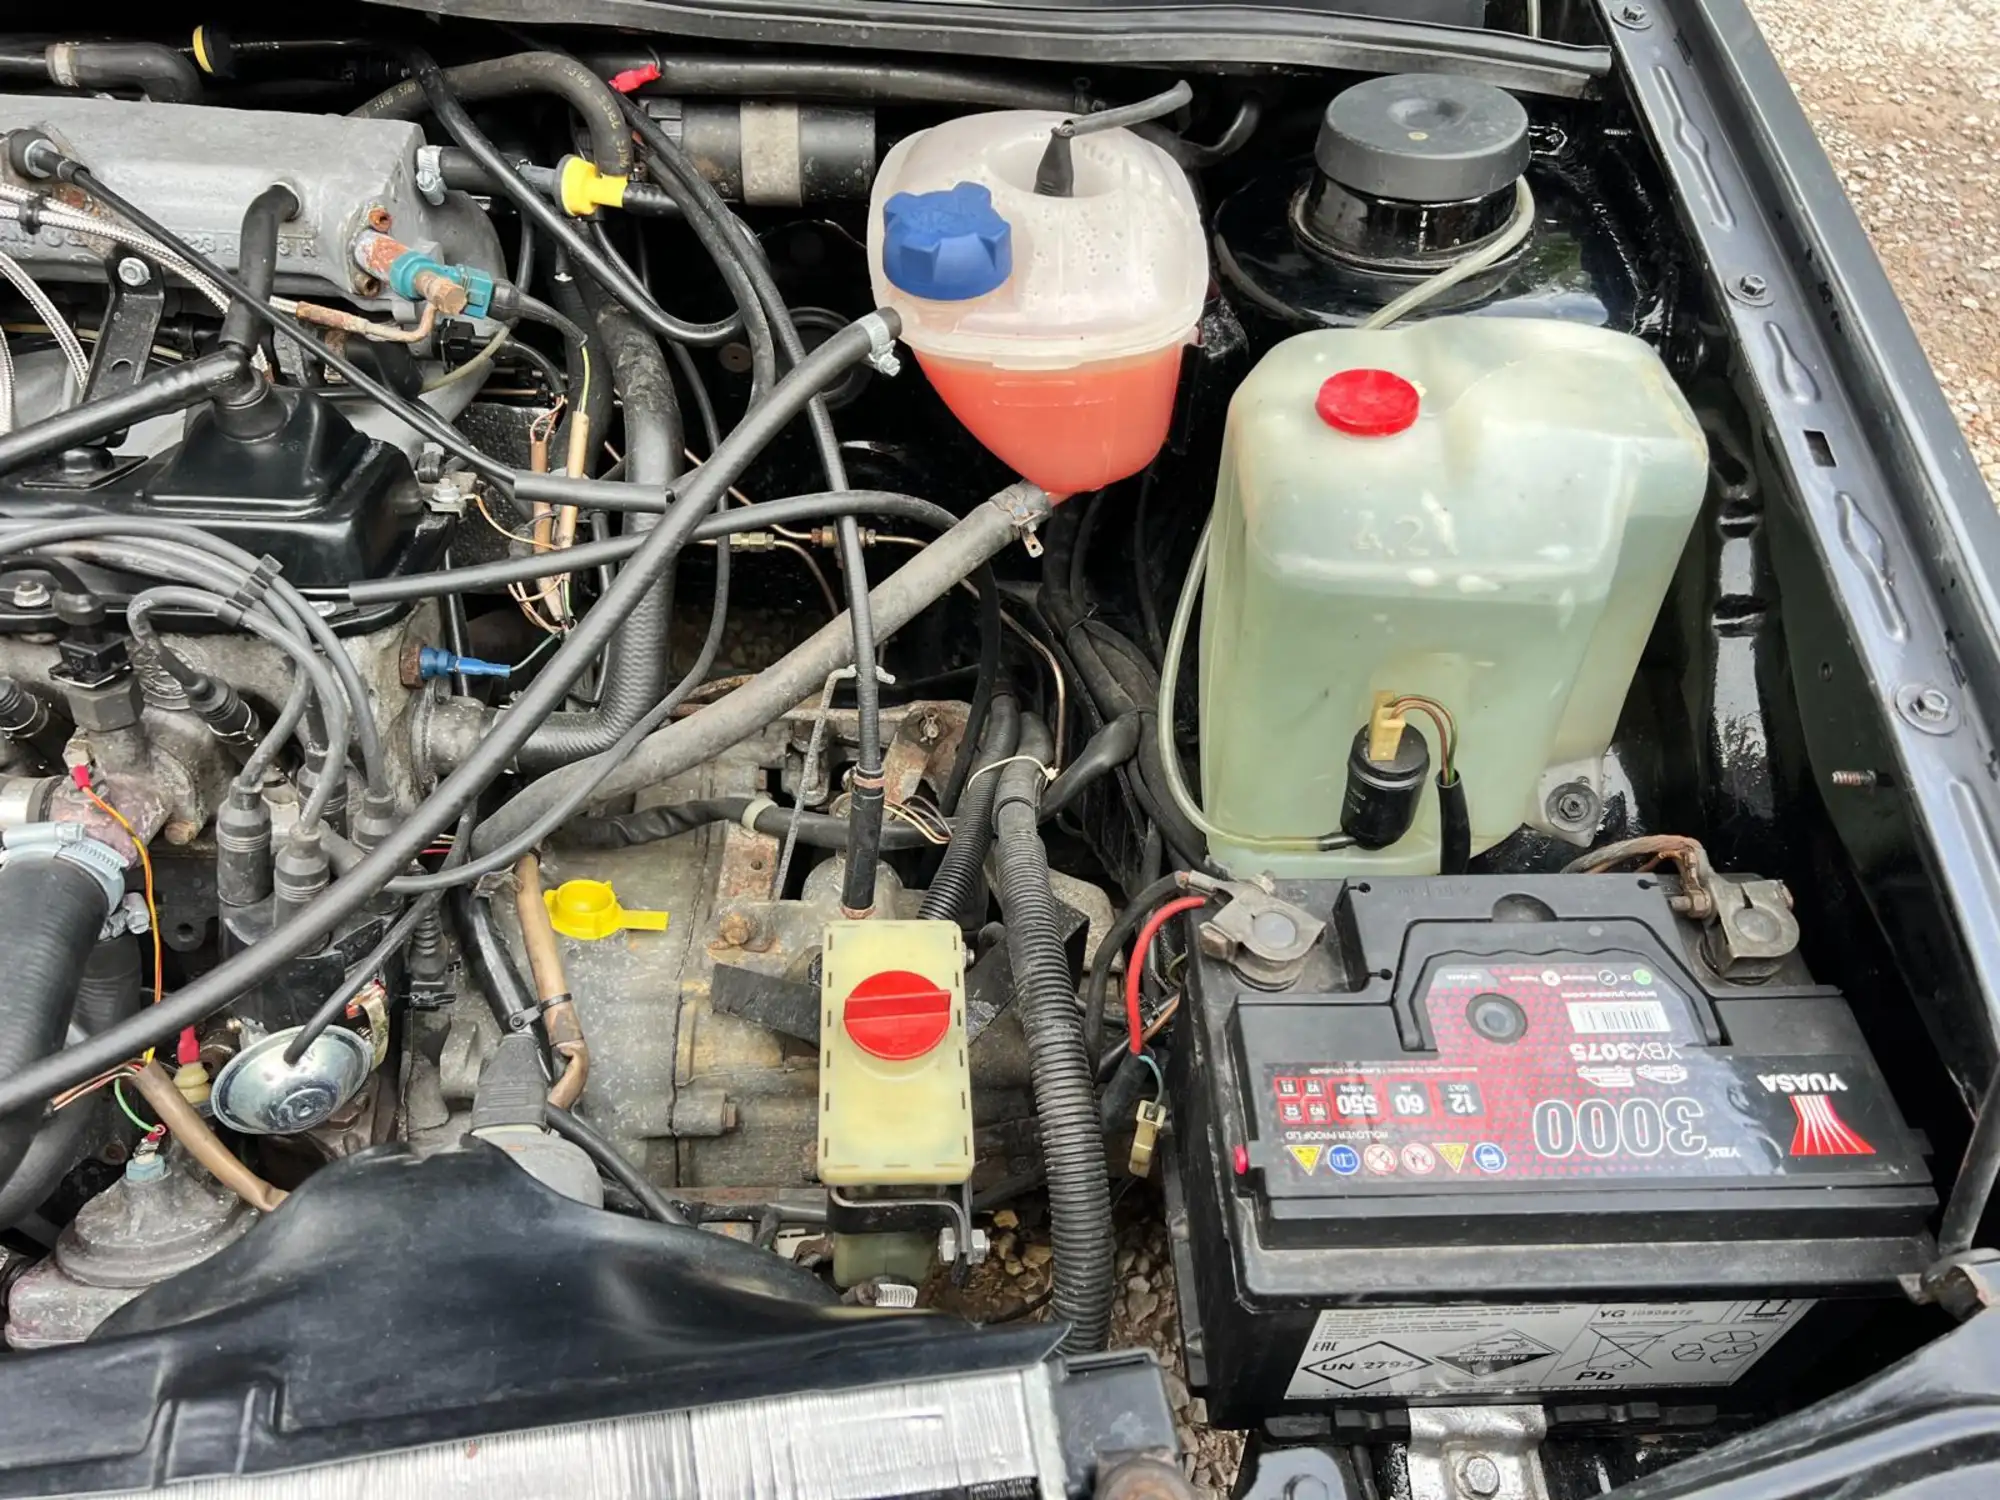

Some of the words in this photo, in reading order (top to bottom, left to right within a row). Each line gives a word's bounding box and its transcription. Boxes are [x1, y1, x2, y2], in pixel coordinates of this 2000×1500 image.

[1568, 1042, 1682, 1061] YBX3075
[1757, 1072, 1848, 1093] YUASA
[1447, 1084, 1470, 1093] VOLT
[1336, 1094, 1379, 1116] 550
[1394, 1093, 1425, 1115] 60
[1448, 1093, 1478, 1114] 12
[1533, 1098, 1707, 1157] 3000
[1304, 1131, 1336, 1140] PROOF
[1707, 1147, 1741, 1158] YBX
[1600, 1309, 1626, 1318] YG
[1457, 1353, 1529, 1362] CORROSIVE
[1322, 1362, 1355, 1371] UN
[1362, 1360, 1414, 1370] 2794
[1575, 1371, 1615, 1381] Pb
